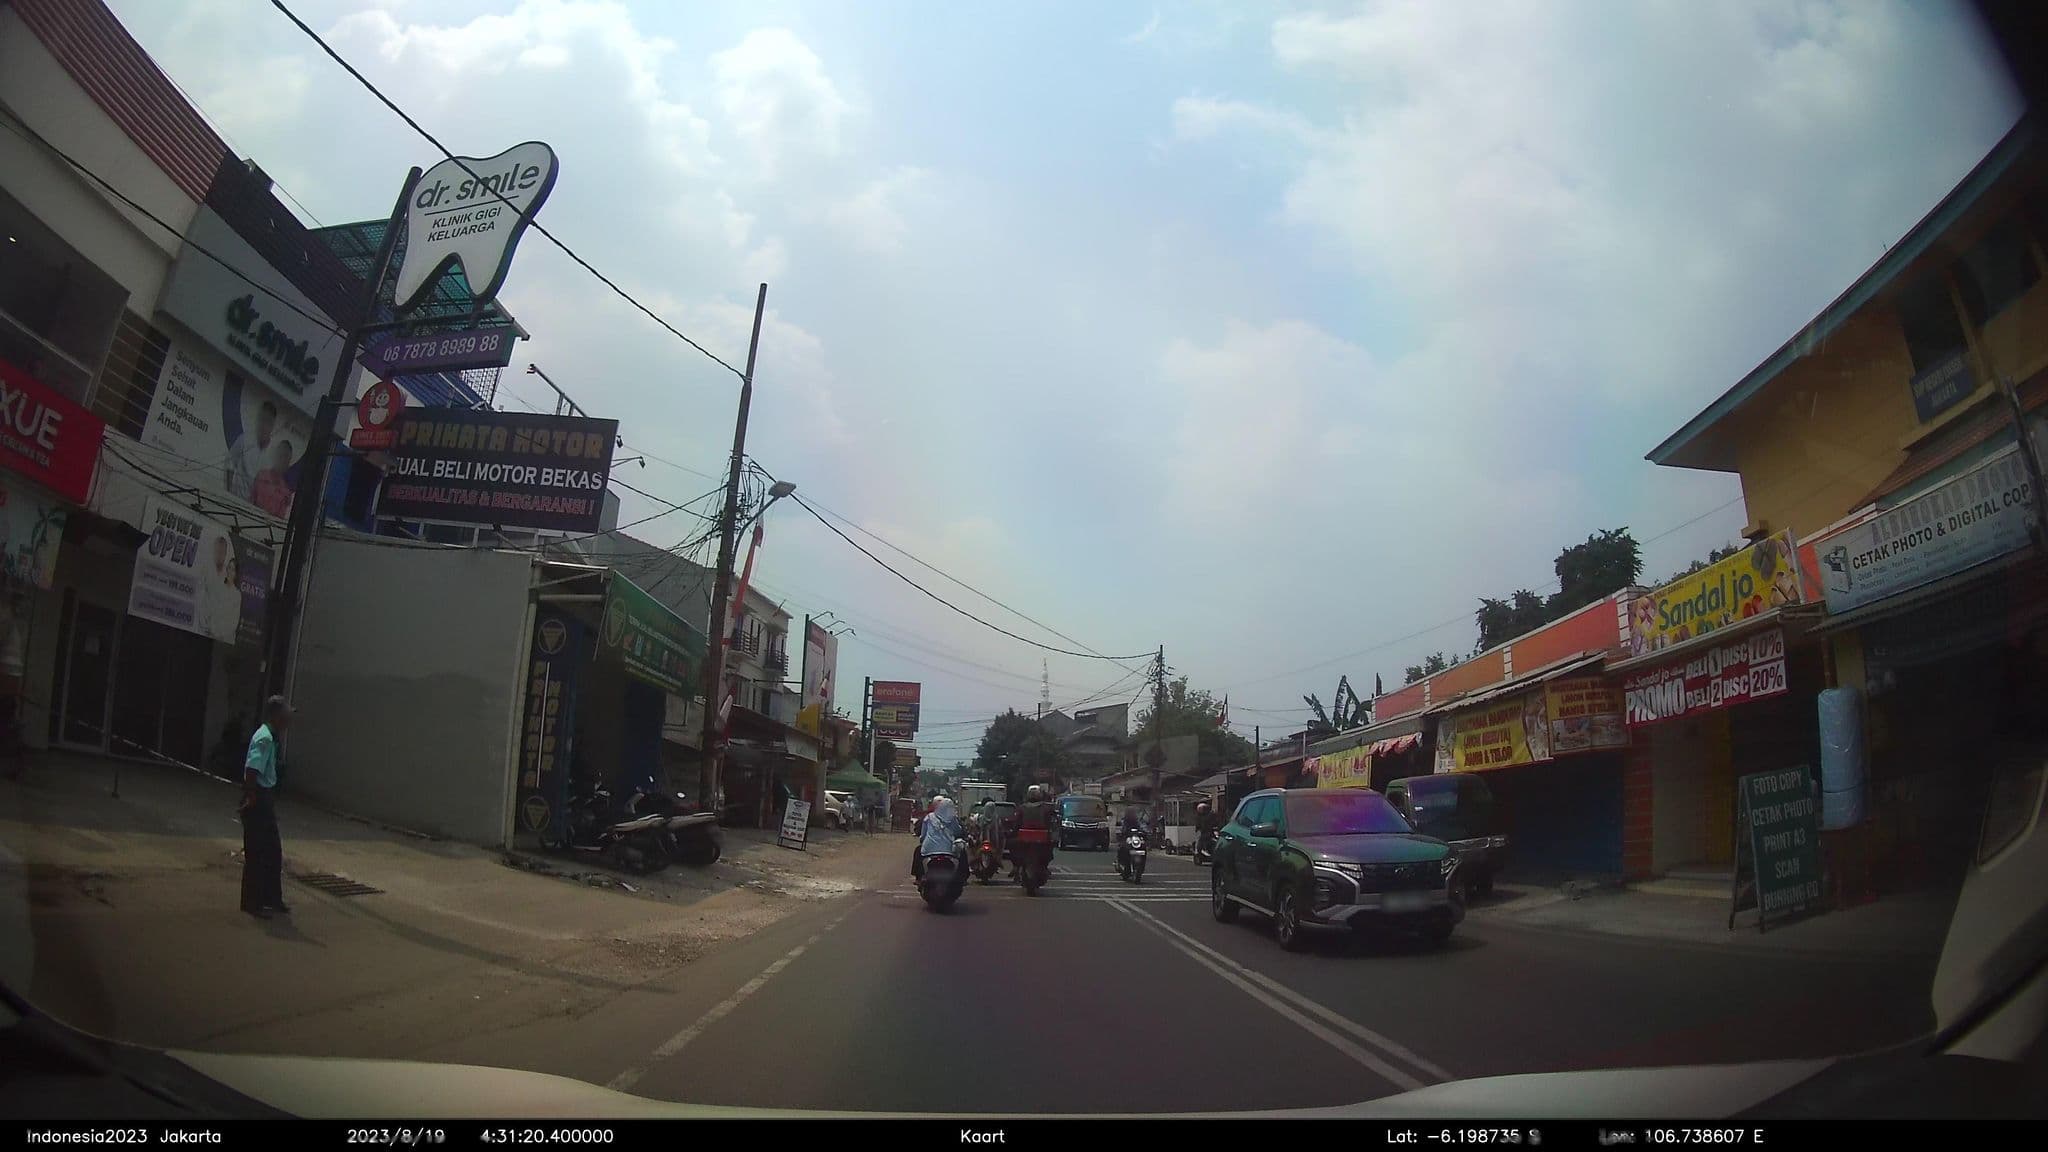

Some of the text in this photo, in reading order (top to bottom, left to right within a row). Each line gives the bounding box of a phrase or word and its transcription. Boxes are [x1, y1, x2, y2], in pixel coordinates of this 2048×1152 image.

[416, 163, 540, 209] dr. smile
[427, 221, 496, 243] KELUARGA
[432, 206, 502, 230] KLINIK GIGI
[383, 334, 499, 363] 08 7878 8989 88
[171, 365, 197, 390] Sehat
[175, 350, 211, 382] Senyum
[166, 379, 195, 406] Dalam
[157, 412, 183, 436] Anda.
[160, 396, 209, 433] Jangkauan
[512, 429, 604, 459] MOTOR
[433, 459, 471, 480] BELI
[473, 463, 536, 486] MOTOR
[540, 467, 603, 491] BEKAS
[390, 485, 479, 504] BERKUALITAS
[1852, 544, 1890, 570] CETAK
[1892, 527, 1933, 555] PHOTO
[1937, 522, 1946, 537] &
[1949, 501, 2000, 532] DIGITAL
[2003, 483, 2033, 508] COP
[149, 525, 199, 568] OPEN
[1658, 569, 1754, 631] Sandal jo
[1722, 643, 1749, 668] DISC
[1751, 632, 1783, 662] 10%
[1713, 683, 1721, 702] 2
[1723, 674, 1750, 699] DISC
[1752, 663, 1783, 692] 20%
[1625, 678, 1687, 724] PROMO
[1753, 769, 1802, 796] FOTO COPY
[1751, 798, 1813, 827] CETAK PHOTO
[1763, 829, 1806, 852] PRINT A3
[1775, 857, 1801, 879] SCAN
